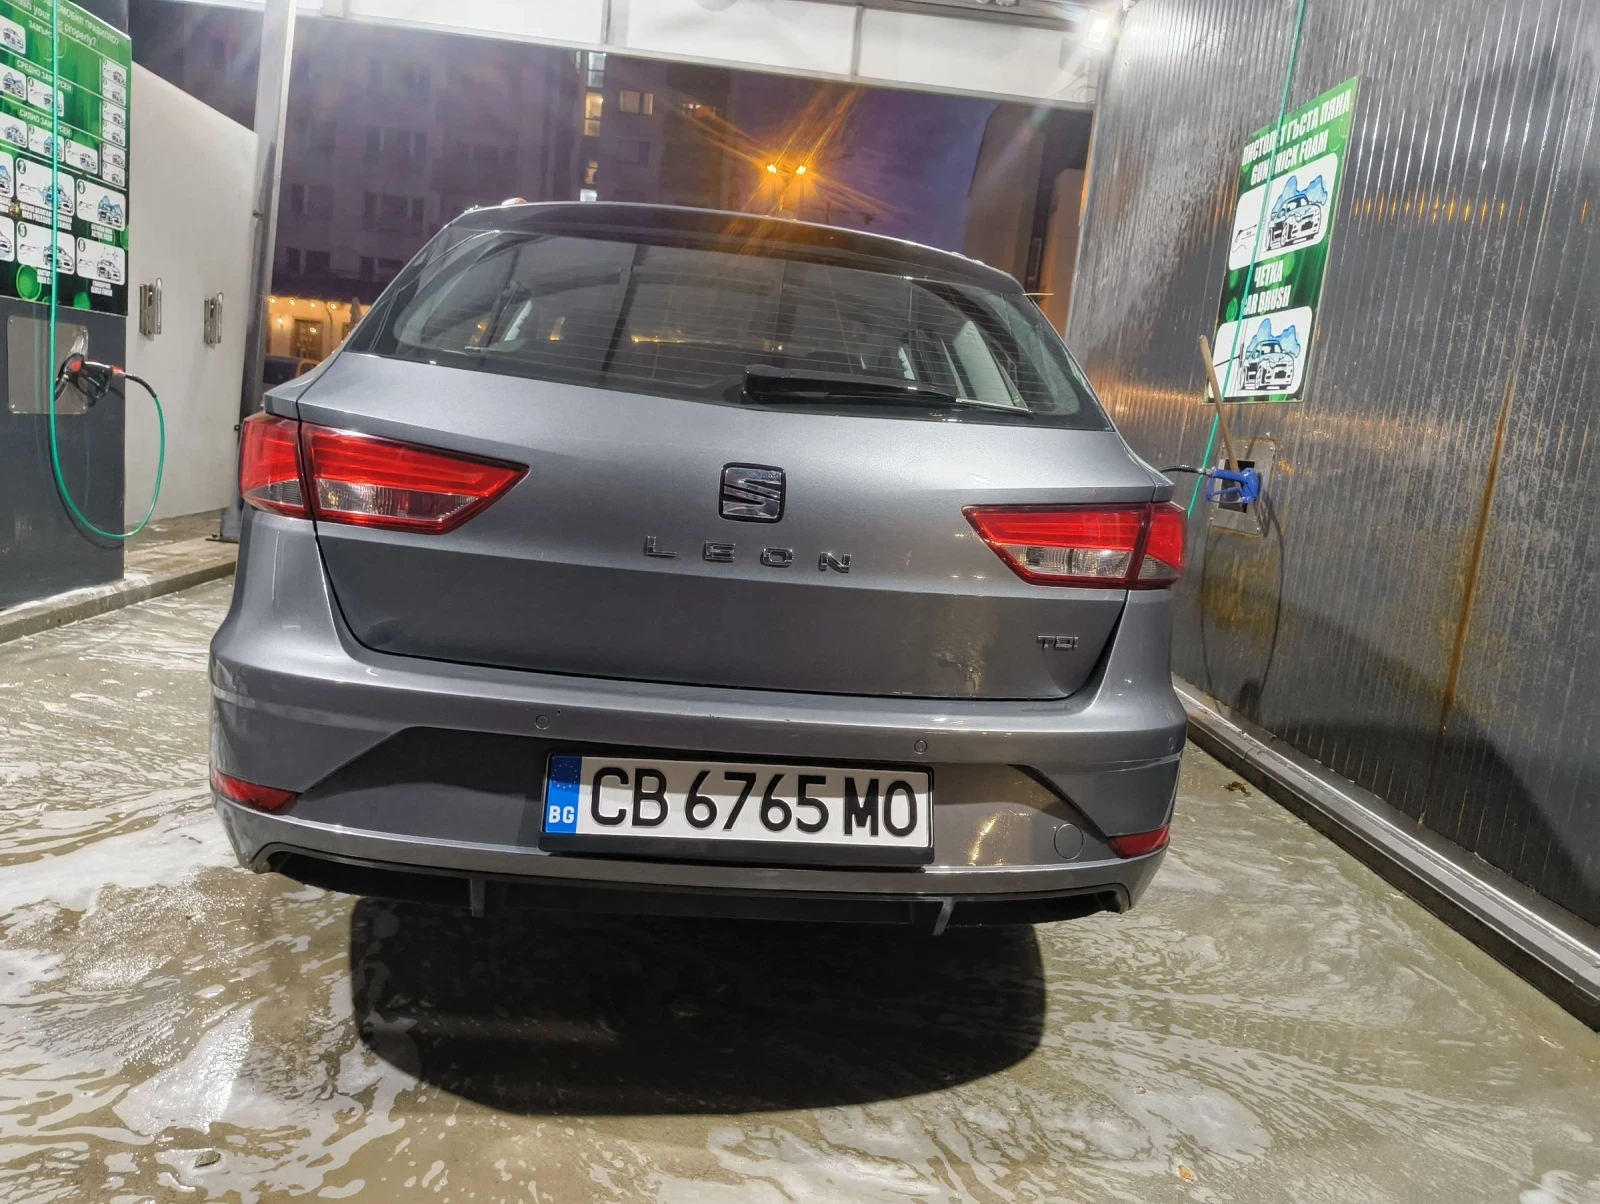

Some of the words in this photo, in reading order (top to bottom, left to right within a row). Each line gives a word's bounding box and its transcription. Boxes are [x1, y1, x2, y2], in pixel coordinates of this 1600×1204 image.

[1241, 124, 1287, 167] ПИСТОЛТ
[1286, 107, 1320, 143] ГЪСТА
[1320, 89, 1351, 125] ПЯНА
[1250, 158, 1270, 186] GUN
[1299, 129, 1329, 163] FOAM
[1254, 260, 1284, 288] ЧЕТКА
[1258, 285, 1292, 313] BRUSH
[643, 535, 852, 574] LEON
[1037, 635, 1079, 650] TDI
[548, 805, 575, 824] BG
[590, 767, 667, 827] CB
[684, 770, 830, 834] 6765
[843, 777, 918, 838] MO
